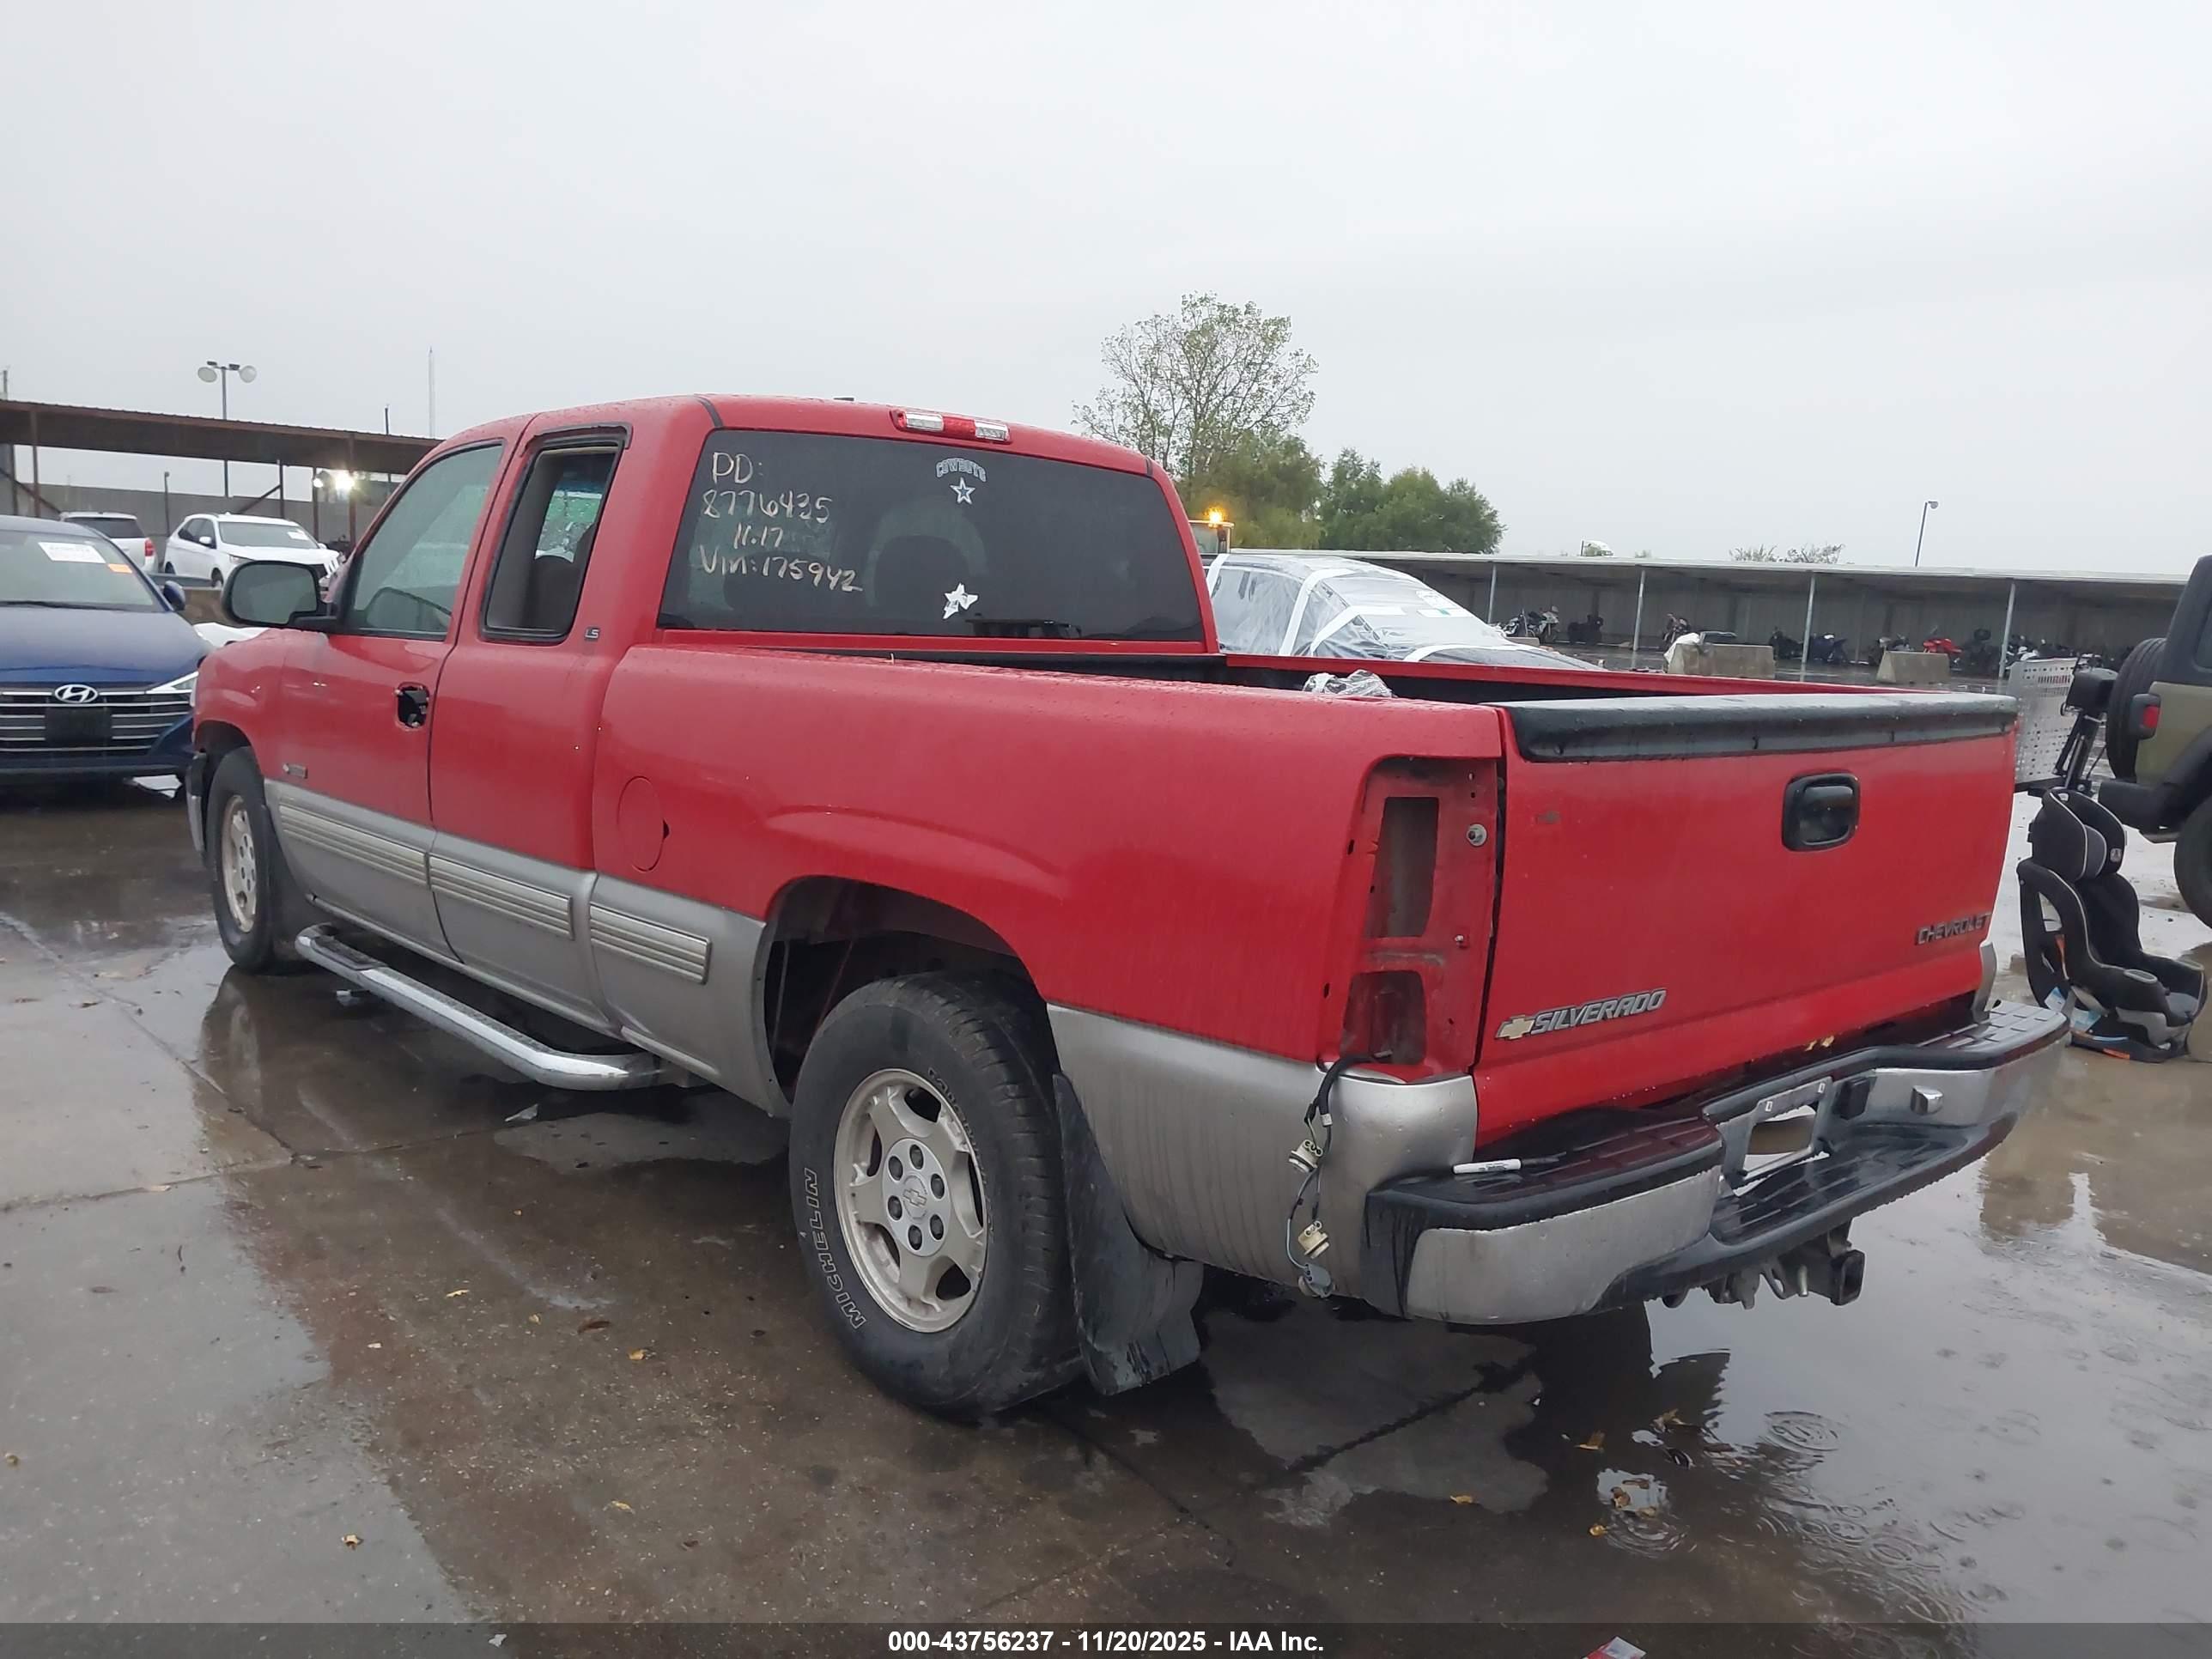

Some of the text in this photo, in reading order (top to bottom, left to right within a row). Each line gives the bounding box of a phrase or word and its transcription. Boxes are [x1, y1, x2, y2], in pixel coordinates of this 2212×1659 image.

[584, 628, 600, 639] LS
[1915, 911, 1992, 945] CHEVROLET
[1530, 988, 1668, 1036] SILVERADO
[804, 1167, 867, 1330] MICHELIN
